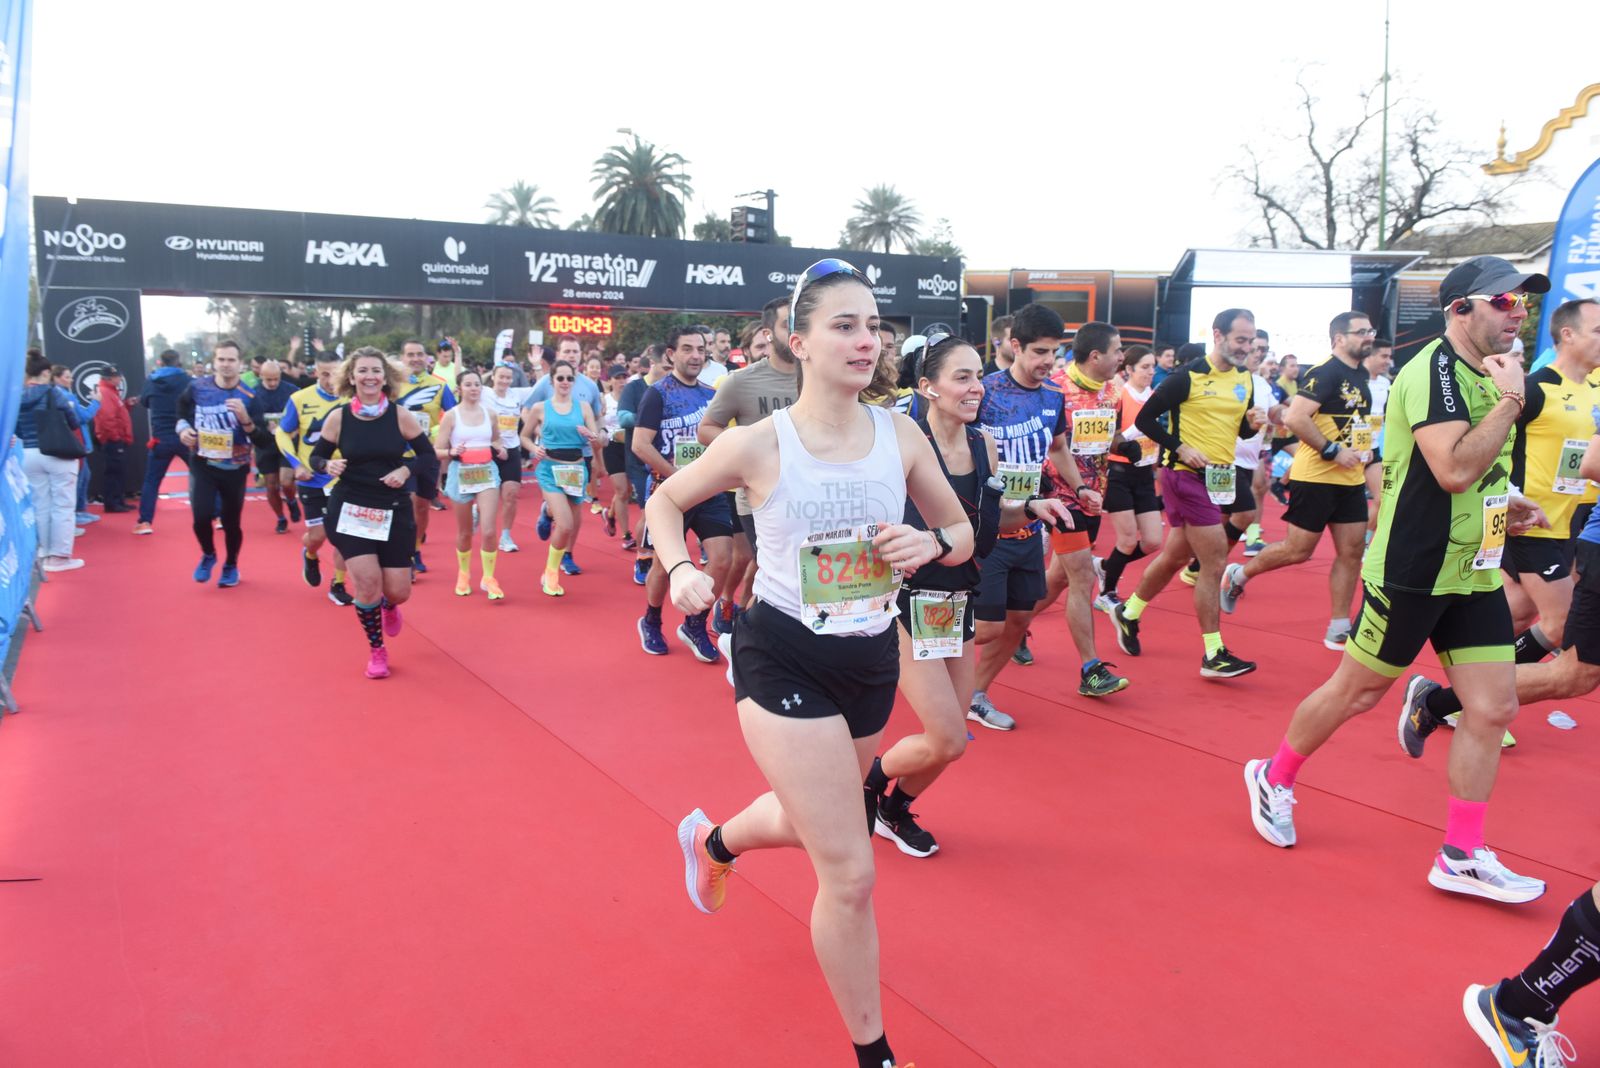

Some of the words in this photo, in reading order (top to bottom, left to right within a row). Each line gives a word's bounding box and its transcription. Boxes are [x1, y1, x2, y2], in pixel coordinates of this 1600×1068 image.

[196, 238, 264, 252] HYUNDAI
[305, 240, 387, 267] HOKA
[1567, 234, 1587, 264] FLY
[550, 252, 638, 272] maratón
[427, 277, 460, 285] Healthcare
[461, 278, 483, 286] Partner
[574, 270, 642, 288] sevilla
[685, 264, 746, 286] HOKA
[562, 289, 574, 298] 28
[576, 291, 601, 299] enero
[602, 291, 624, 300] 2024
[549, 315, 612, 334] 00:04:23
[1006, 415, 1043, 439] MARATÓN
[1077, 420, 1109, 434] 13134
[994, 427, 1053, 464] EVILLA
[820, 481, 863, 499] THE
[785, 500, 865, 519] NORTH
[824, 528, 853, 540] MARATÓN
[817, 547, 885, 585] 8245
[1533, 934, 1600, 996] Kalenji
